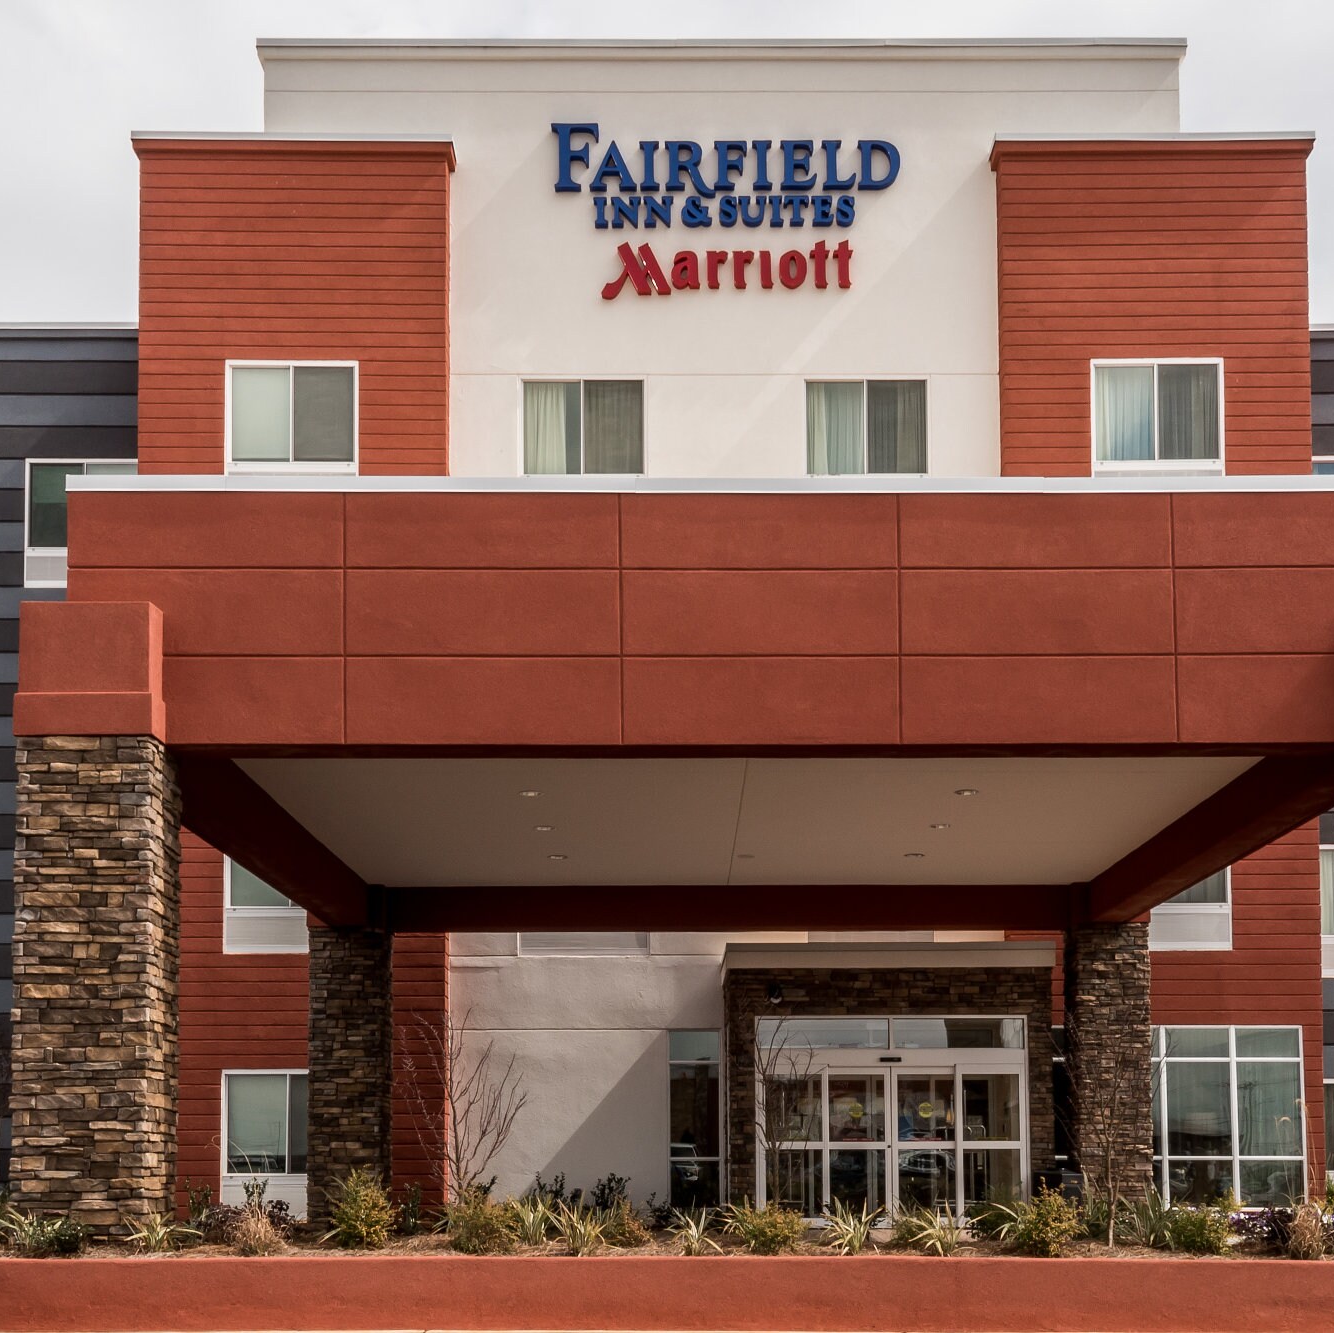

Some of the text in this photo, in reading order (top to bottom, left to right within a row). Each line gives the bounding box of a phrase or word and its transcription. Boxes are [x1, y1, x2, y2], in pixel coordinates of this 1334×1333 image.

[551, 122, 901, 198] FAIRFIELD
[593, 195, 856, 229] INN & SUITES
[601, 239, 854, 300] Marriott
